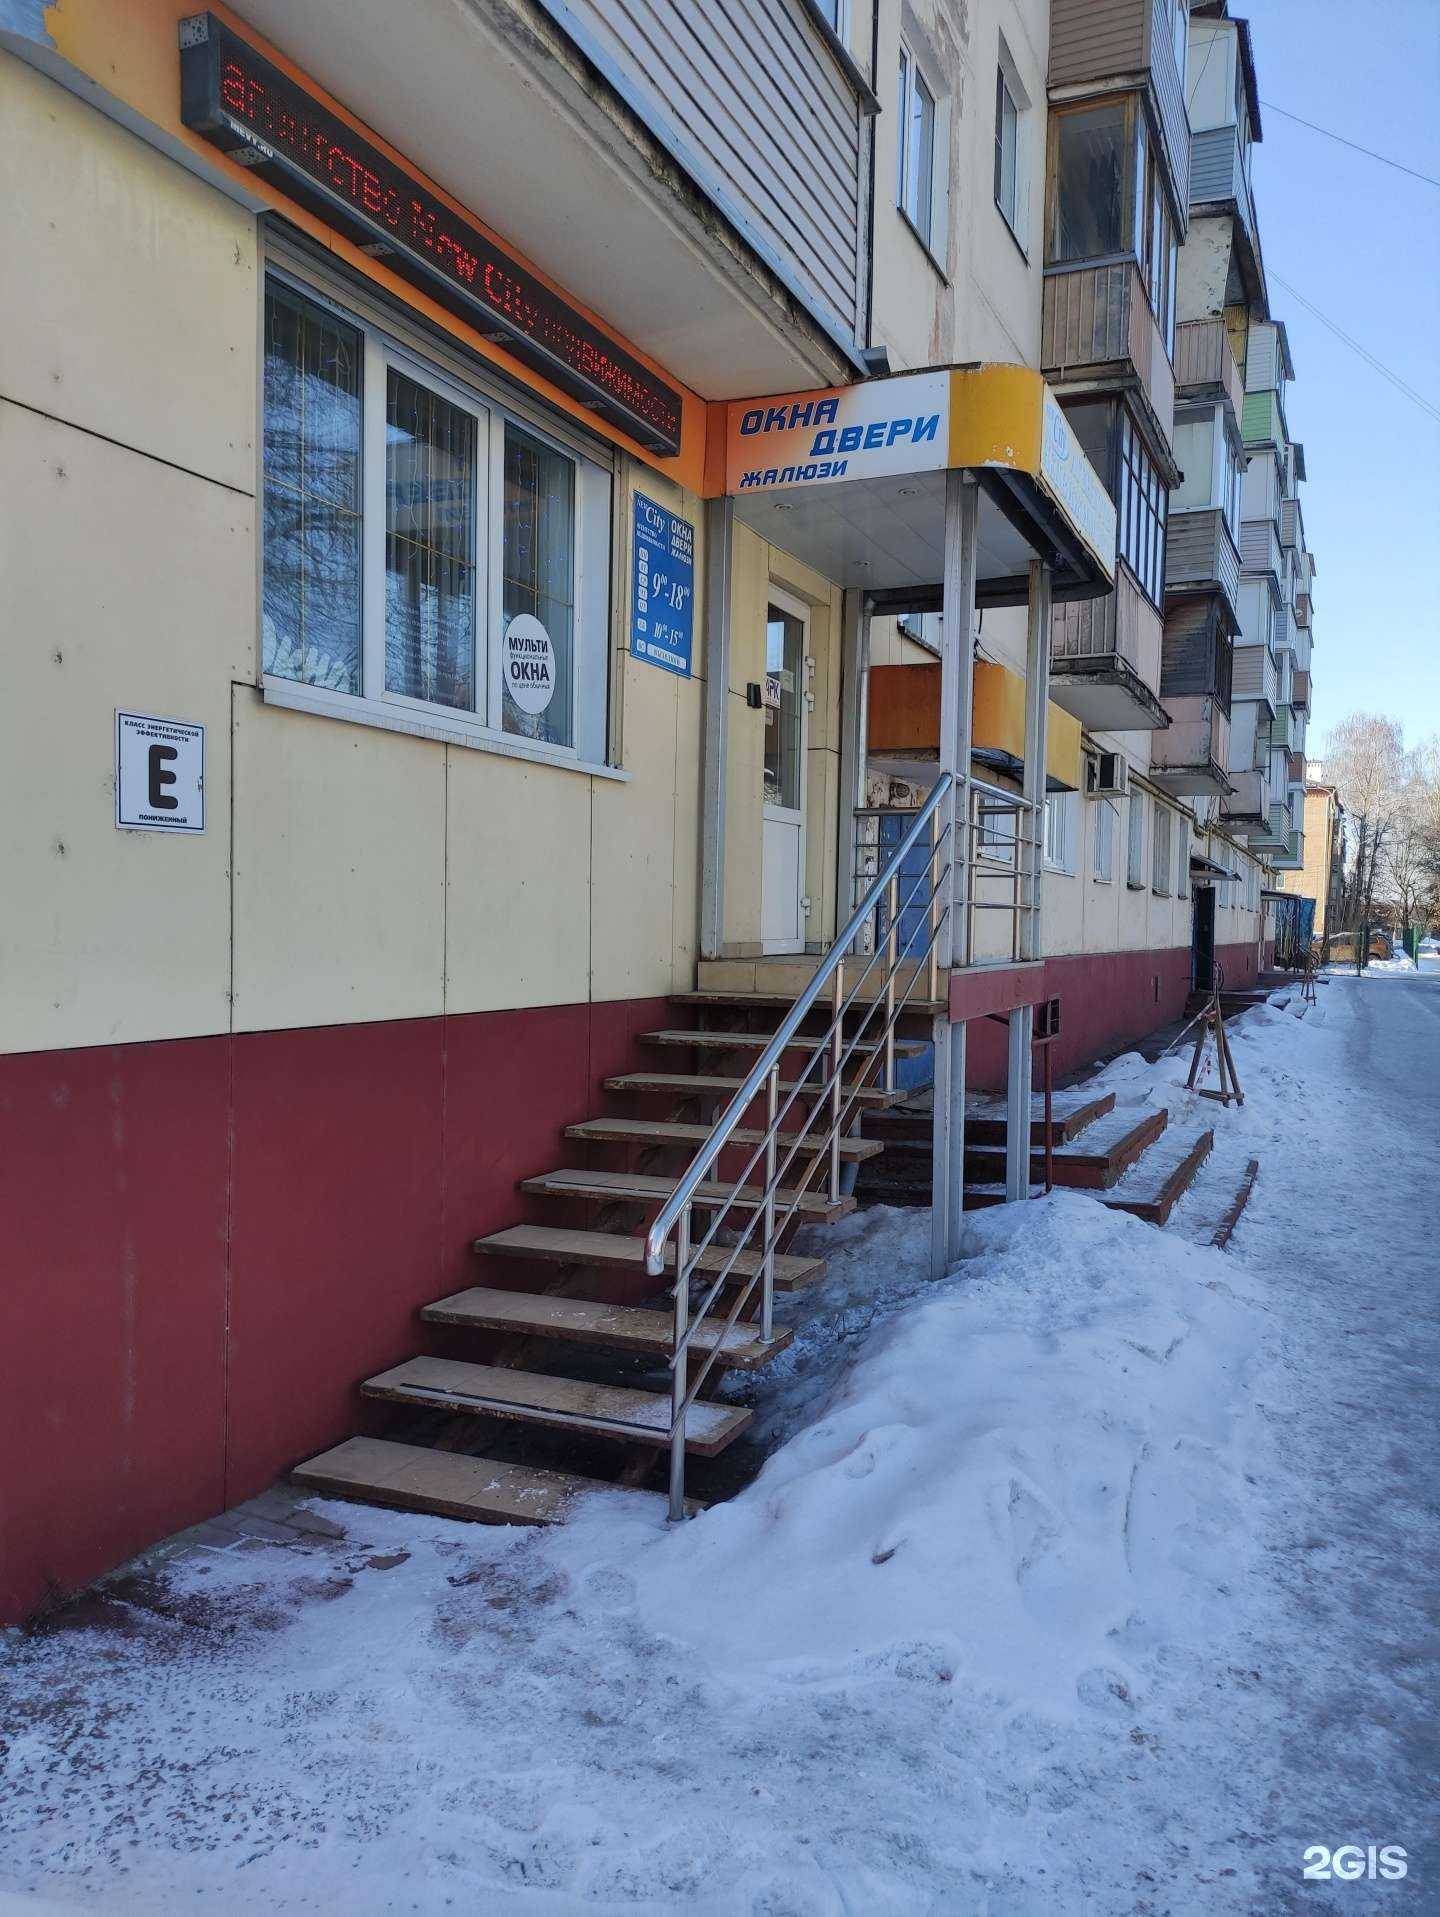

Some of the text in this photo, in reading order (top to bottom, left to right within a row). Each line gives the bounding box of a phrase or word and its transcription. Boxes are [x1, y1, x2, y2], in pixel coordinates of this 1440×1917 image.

[740, 398, 840, 437] ОКНА
[809, 414, 941, 457] ДВЕРИ
[739, 460, 849, 489] ЖАЛЮЗИ
[645, 506, 666, 534] City
[671, 519, 692, 543] ОКНА
[670, 535, 692, 555] ДВЕРИ
[508, 636, 549, 653] МУЛЬТИ
[510, 661, 550, 682] ОКНА
[124, 720, 199, 738] КЛАСС ЭНЕРГЕТИЧЕСКОЙ
[136, 730, 190, 743] ЭФФЕКТИВНОСТИ
[138, 814, 188, 824] ПОНИЖЕННЫЙ
